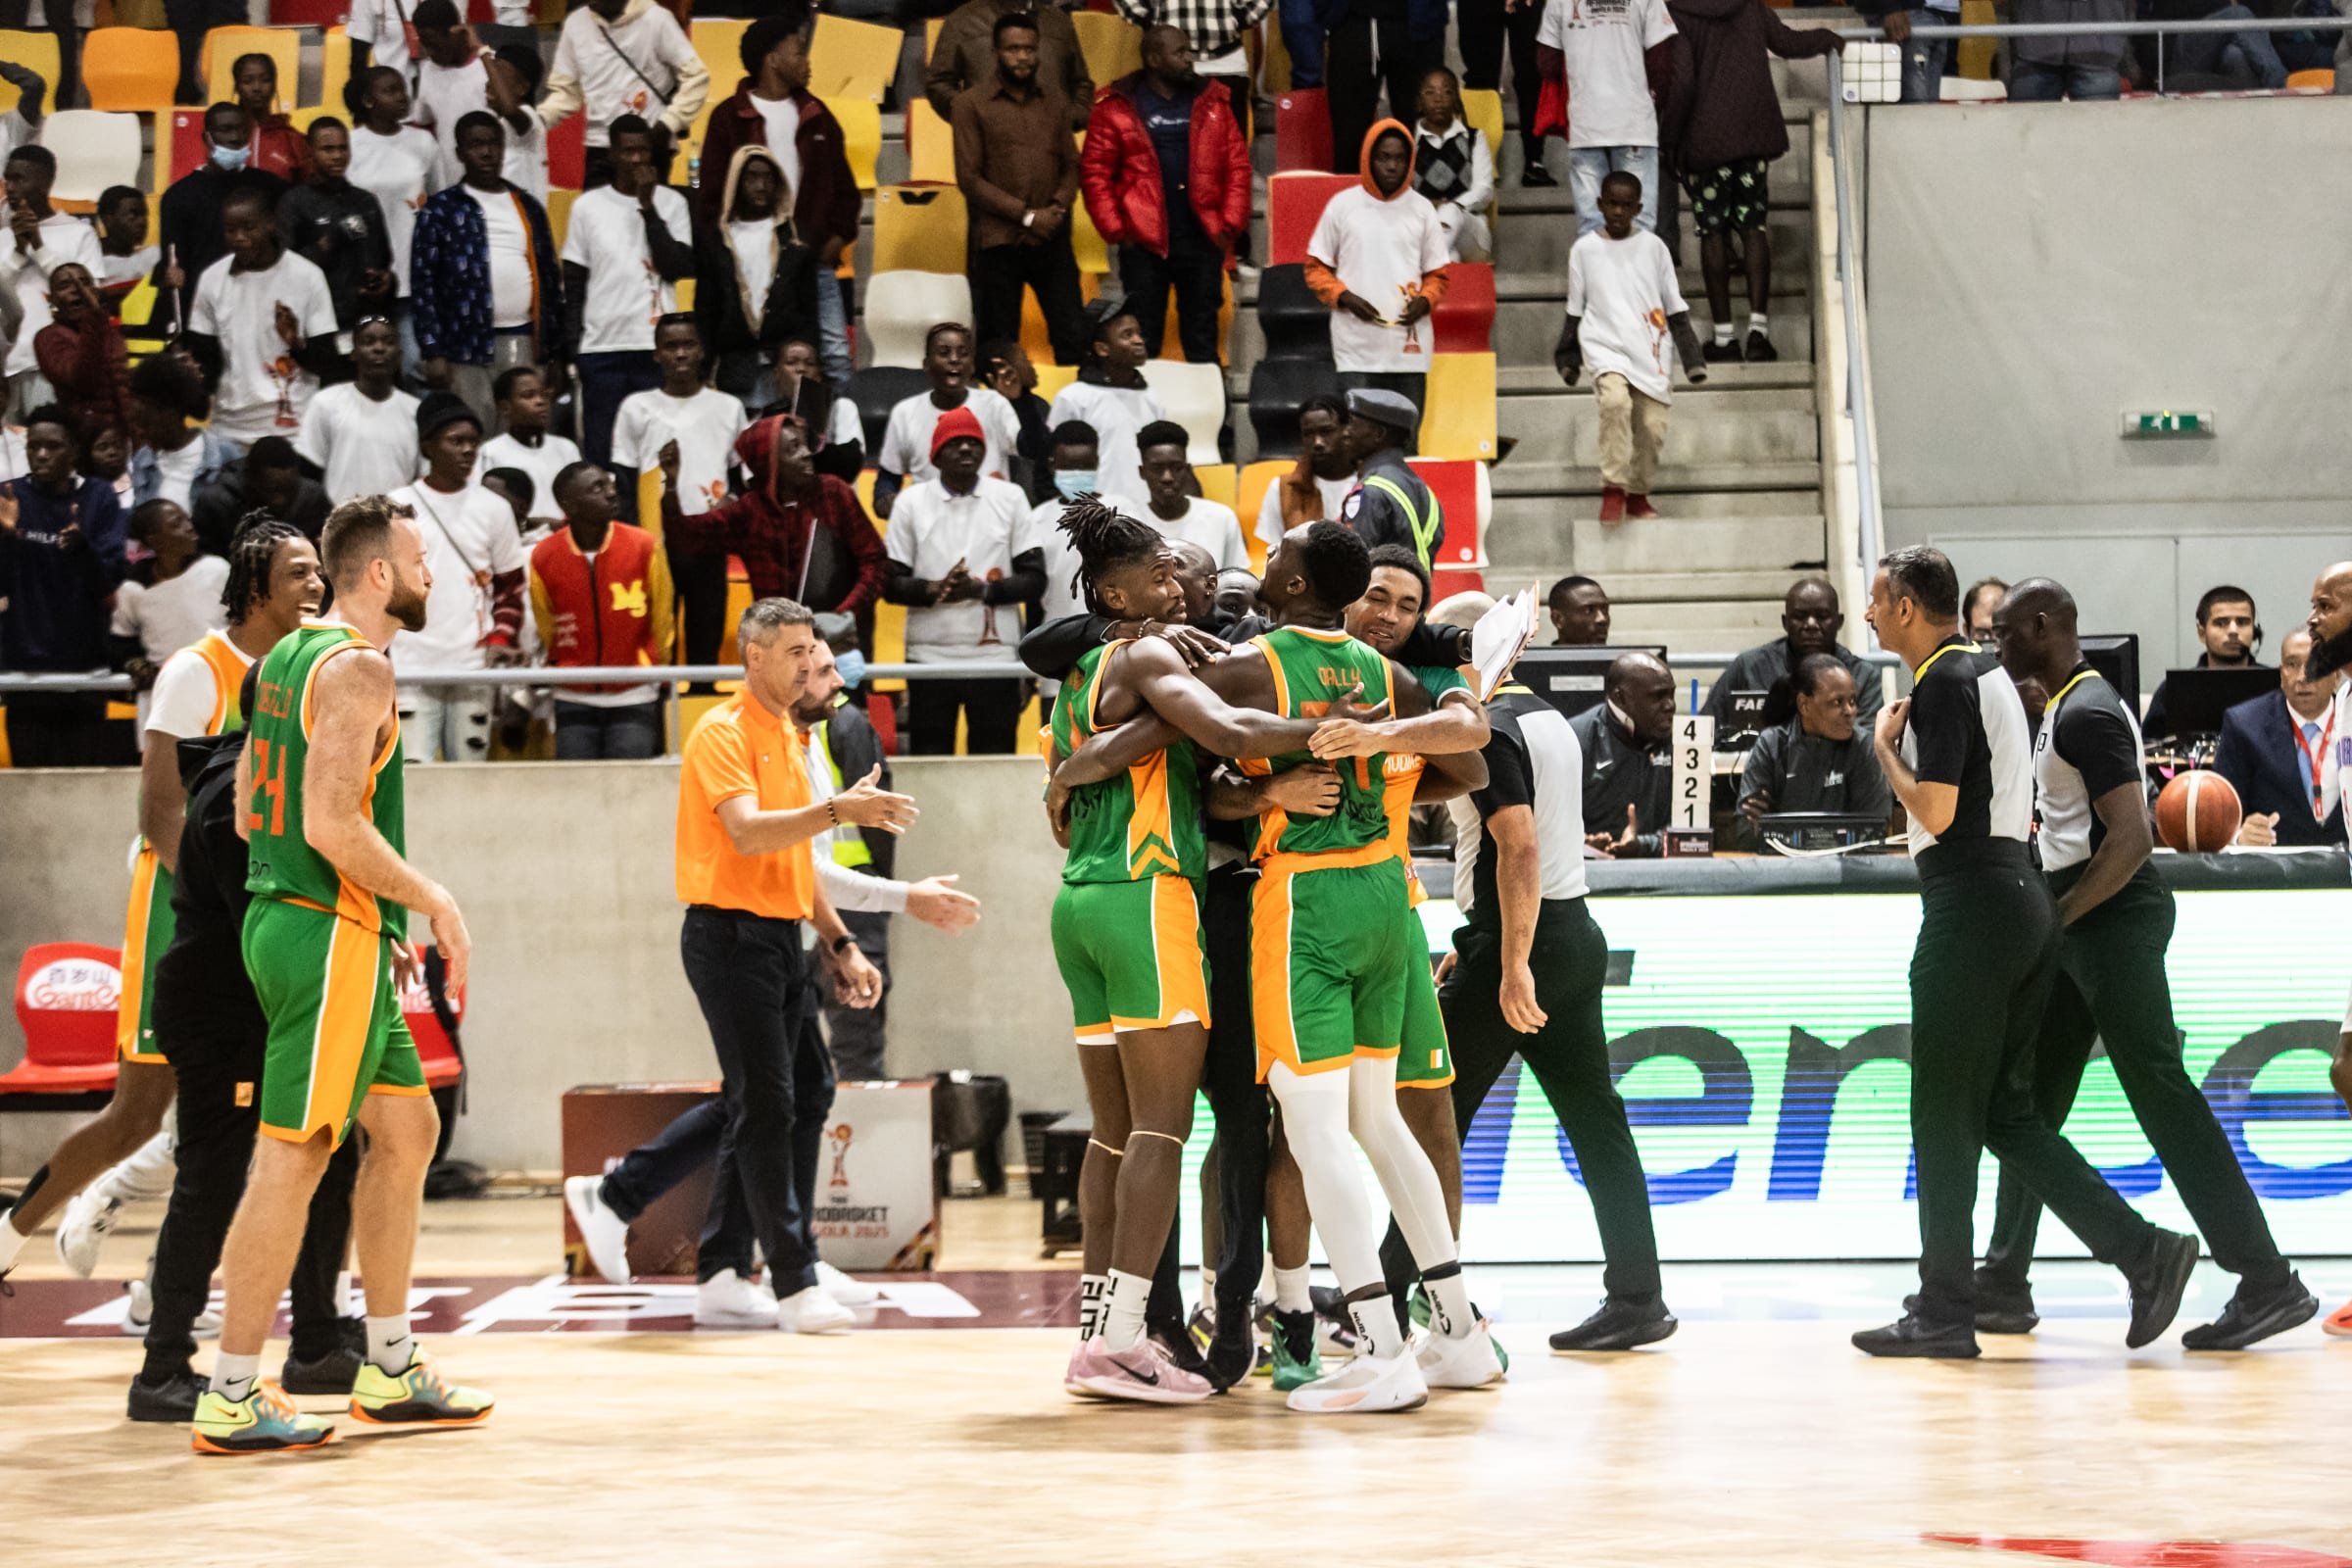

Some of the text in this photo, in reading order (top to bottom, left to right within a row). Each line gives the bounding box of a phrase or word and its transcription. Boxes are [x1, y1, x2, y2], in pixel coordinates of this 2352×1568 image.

[1684, 719, 1696, 741] 4
[1686, 748, 1698, 769] 3
[1685, 777, 1697, 799] 2
[1684, 804, 1693, 827] 1
